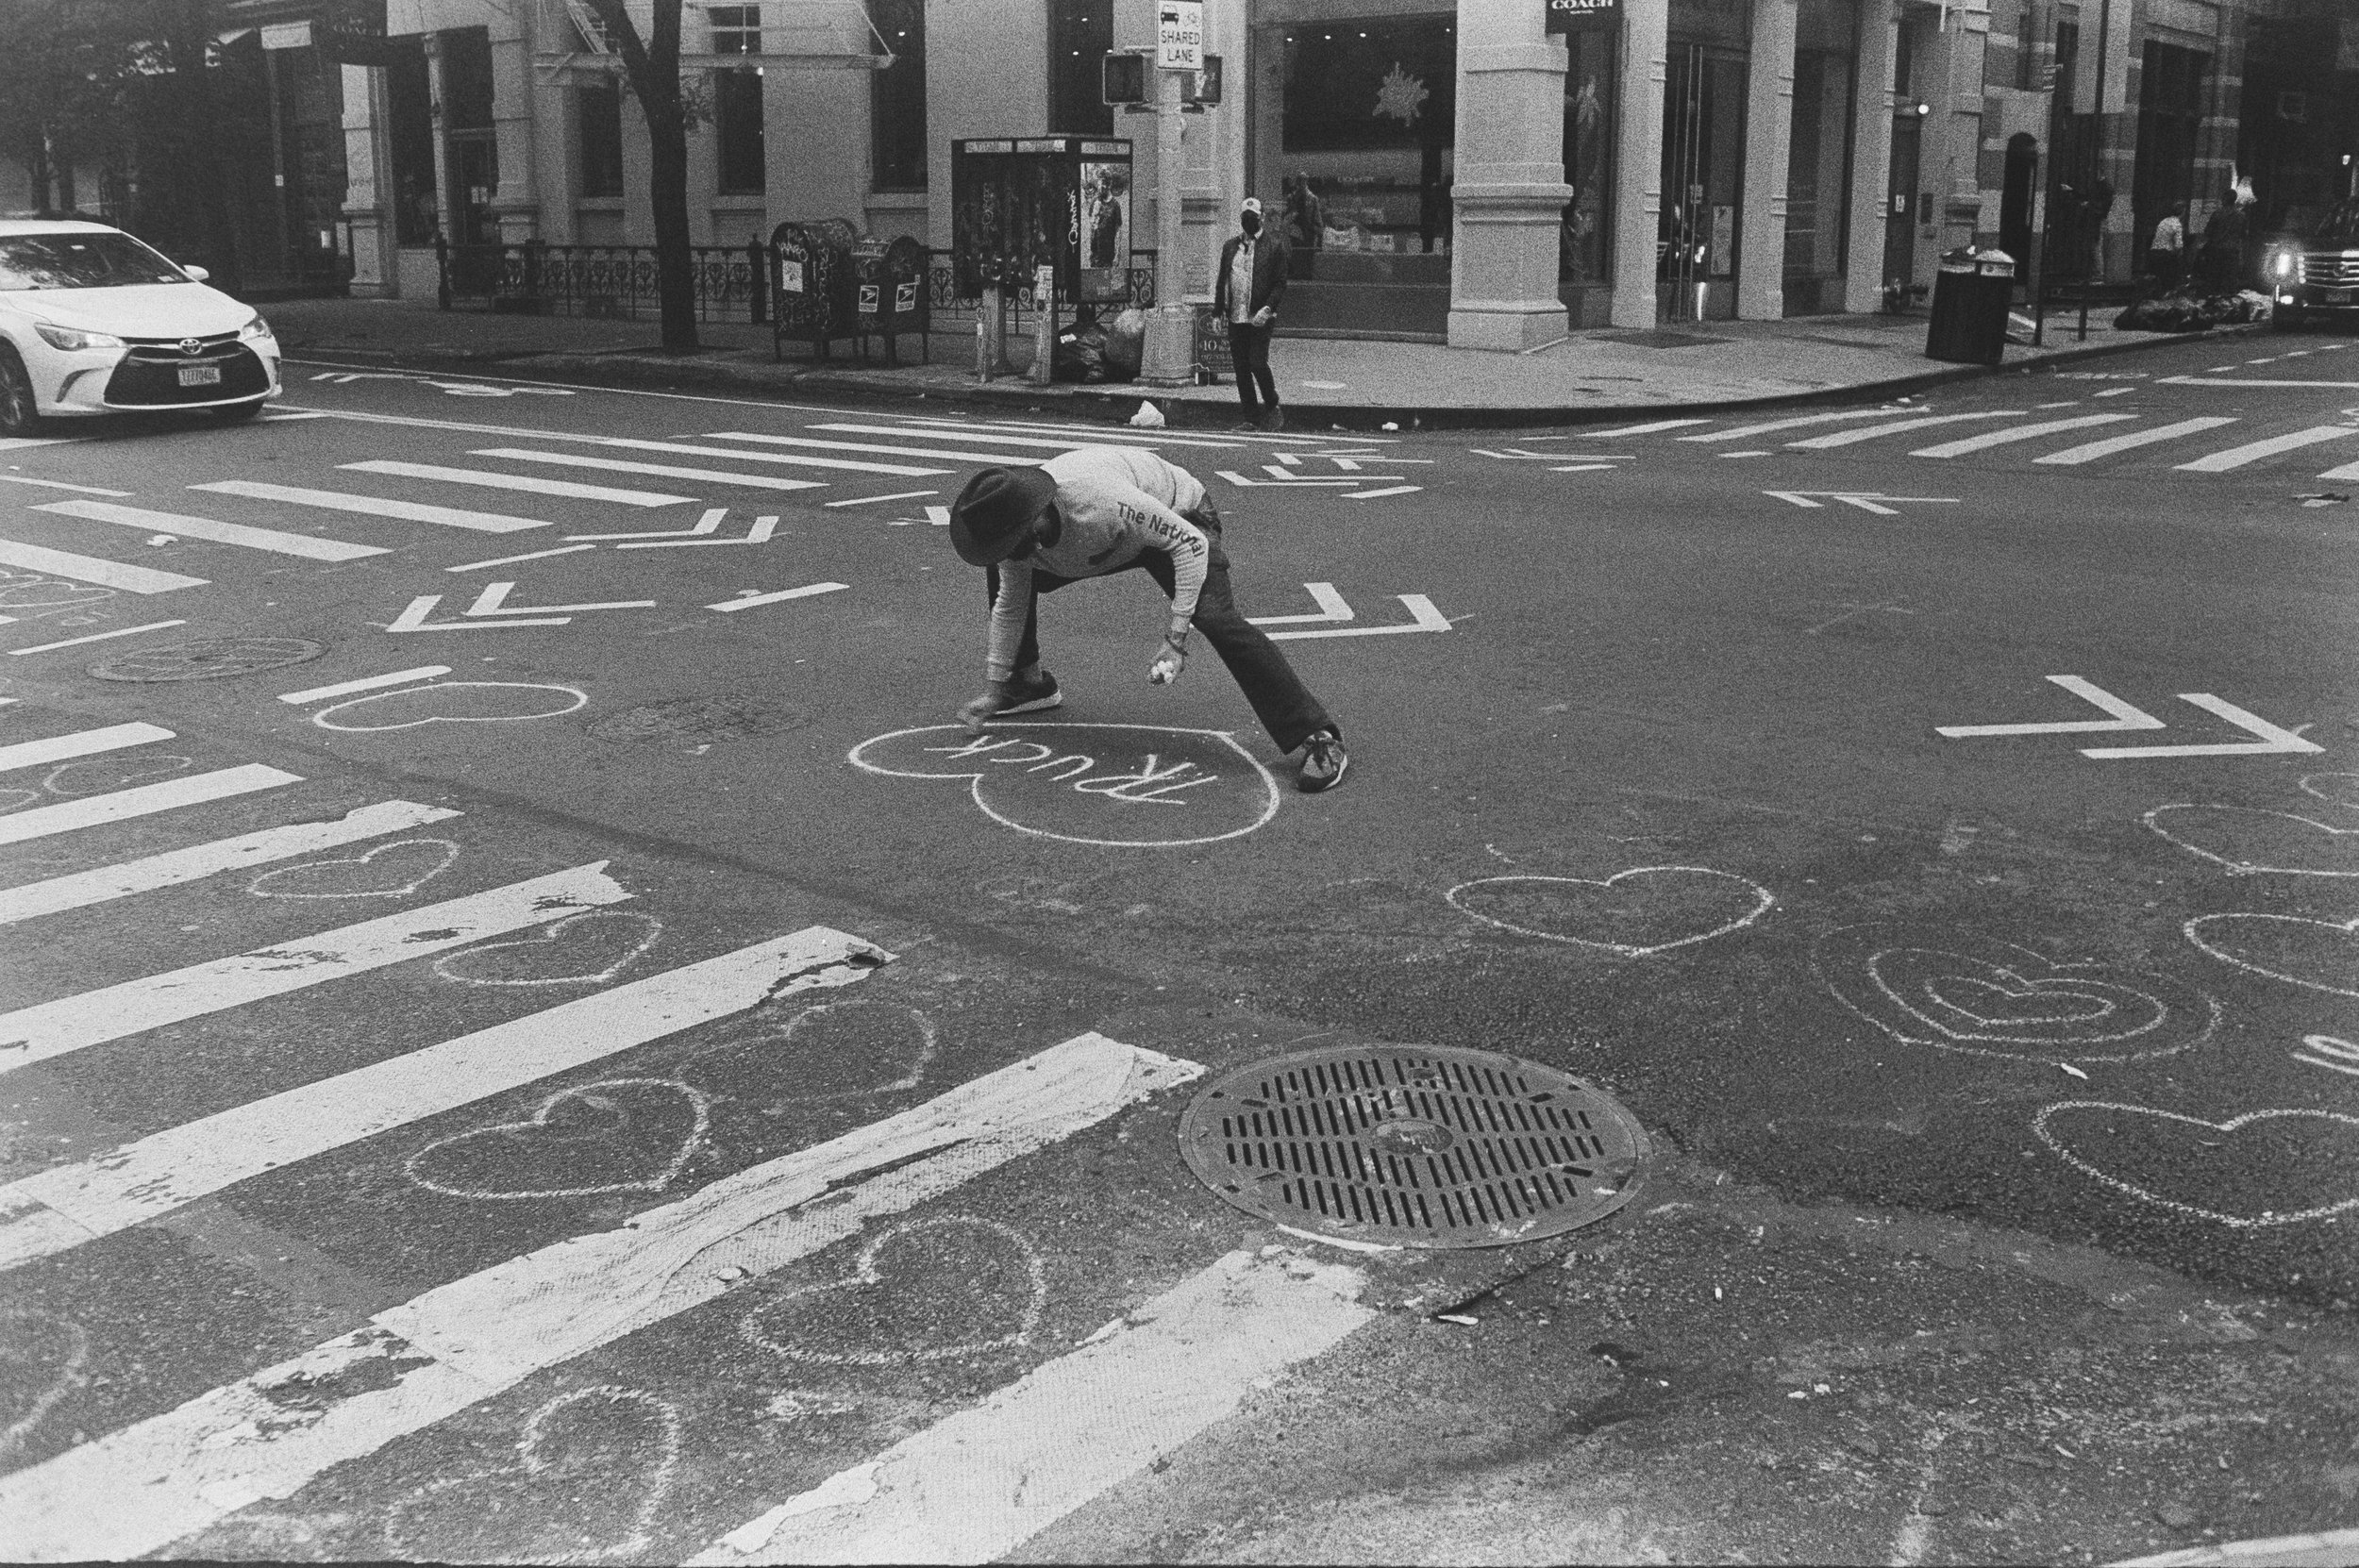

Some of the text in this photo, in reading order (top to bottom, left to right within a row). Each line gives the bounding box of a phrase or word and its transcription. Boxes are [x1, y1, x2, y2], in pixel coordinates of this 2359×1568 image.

[1161, 30, 1200, 44] SHARED
[1167, 48, 1193, 62] LANE
[1117, 502, 1205, 558] The National
